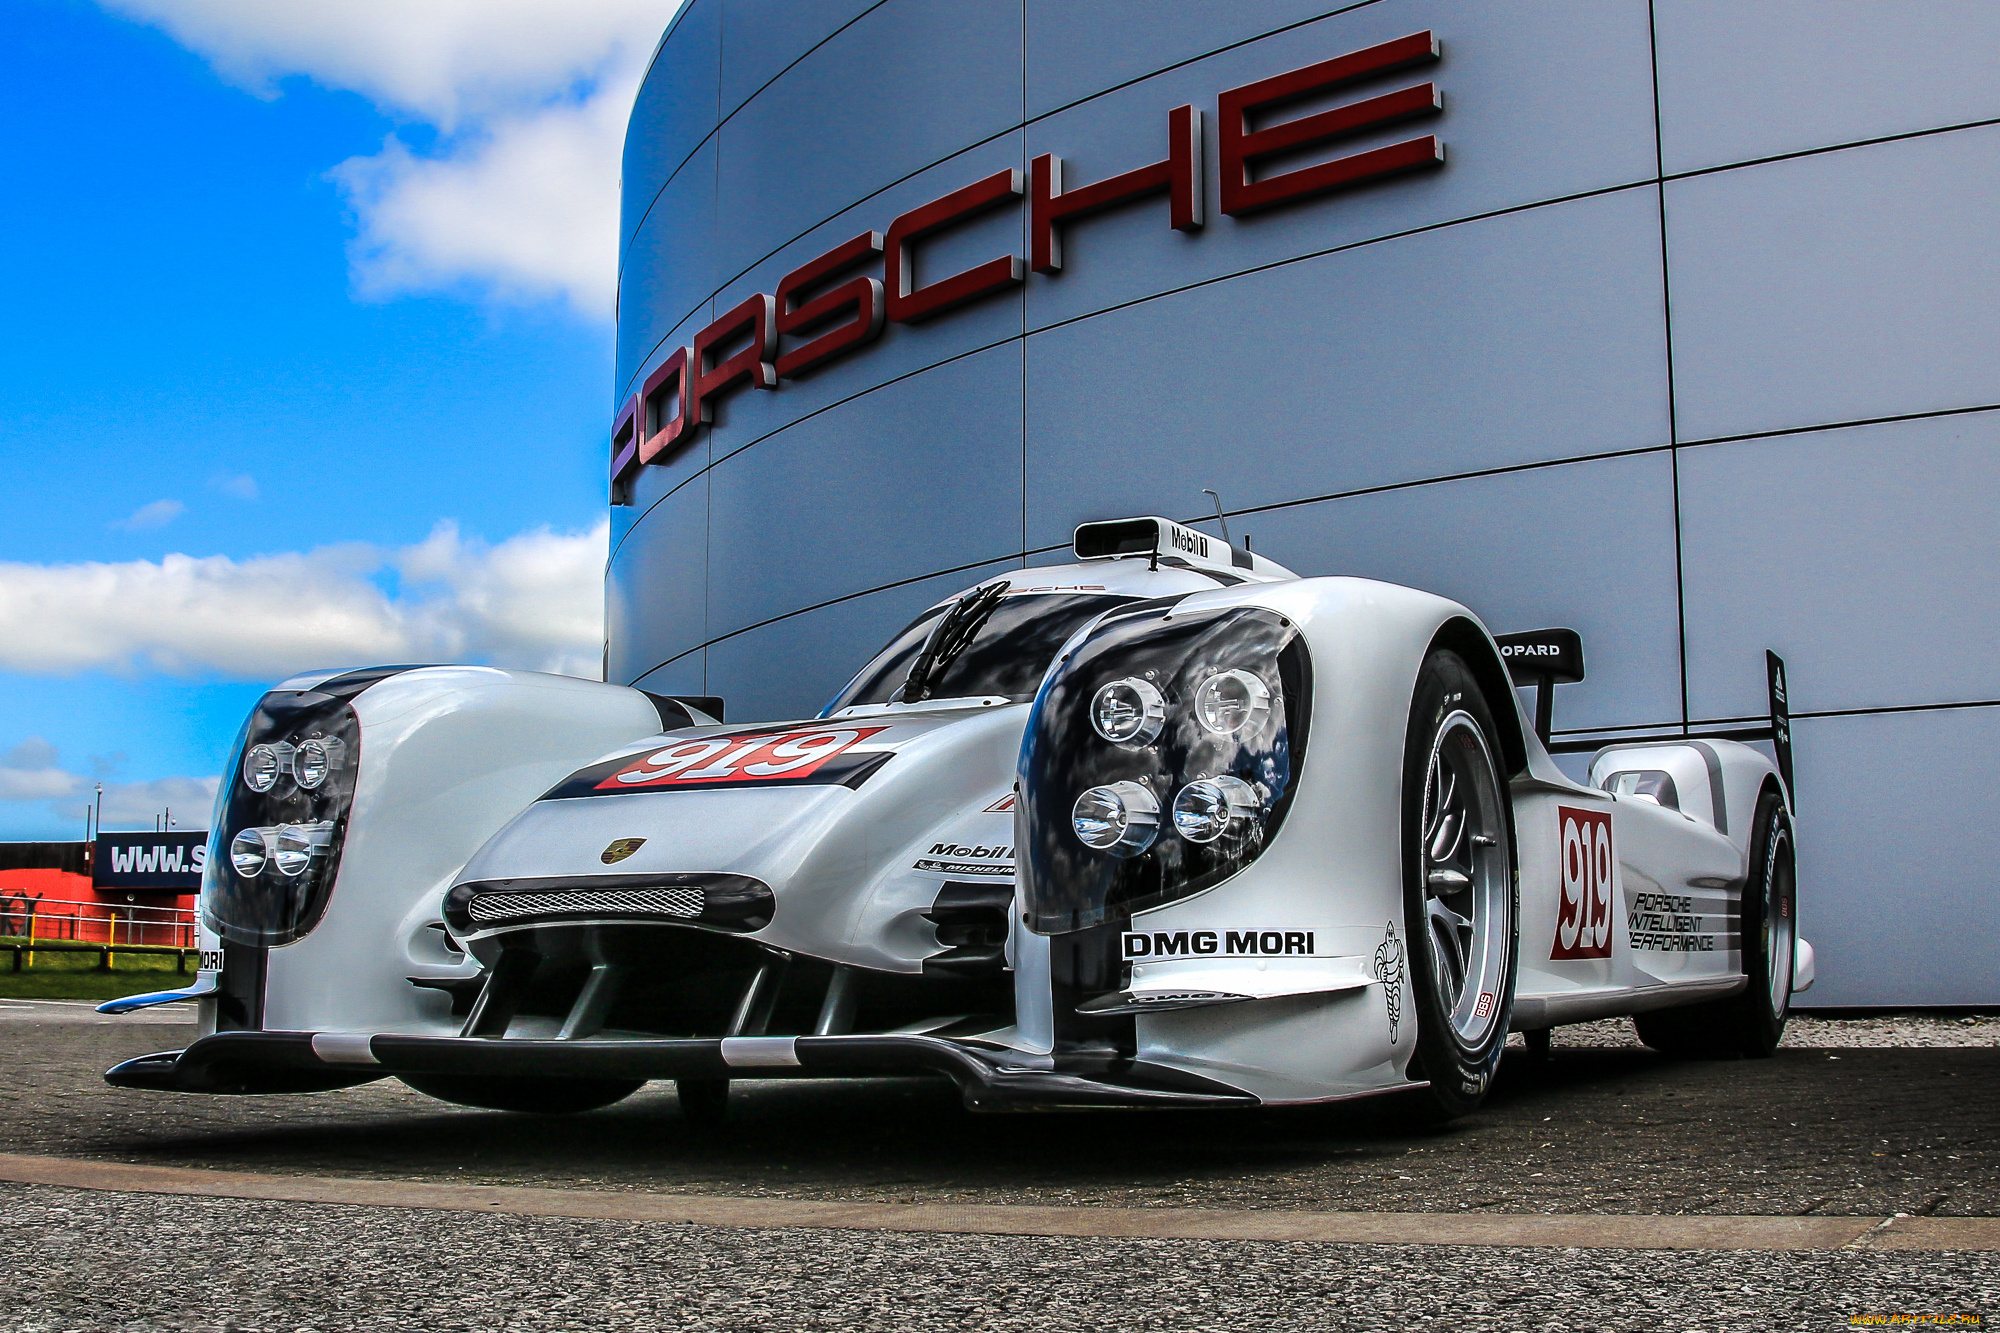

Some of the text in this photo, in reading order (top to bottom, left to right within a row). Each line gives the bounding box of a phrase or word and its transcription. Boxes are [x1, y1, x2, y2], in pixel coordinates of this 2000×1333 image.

[610, 29, 1444, 506] PORSCHE
[1499, 644, 1560, 657] OPARD
[617, 730, 860, 784] 919
[928, 843, 1008, 858] Mobil
[1560, 816, 1611, 950] 919
[1634, 892, 1692, 913] PORSCHE
[1628, 912, 1702, 932] INTELLIGENT
[1124, 931, 1315, 957] DMG MORI
[1629, 931, 1714, 952] ERFORMANCE
[199, 951, 223, 970] ORI
[1475, 993, 1492, 1017] BBS
